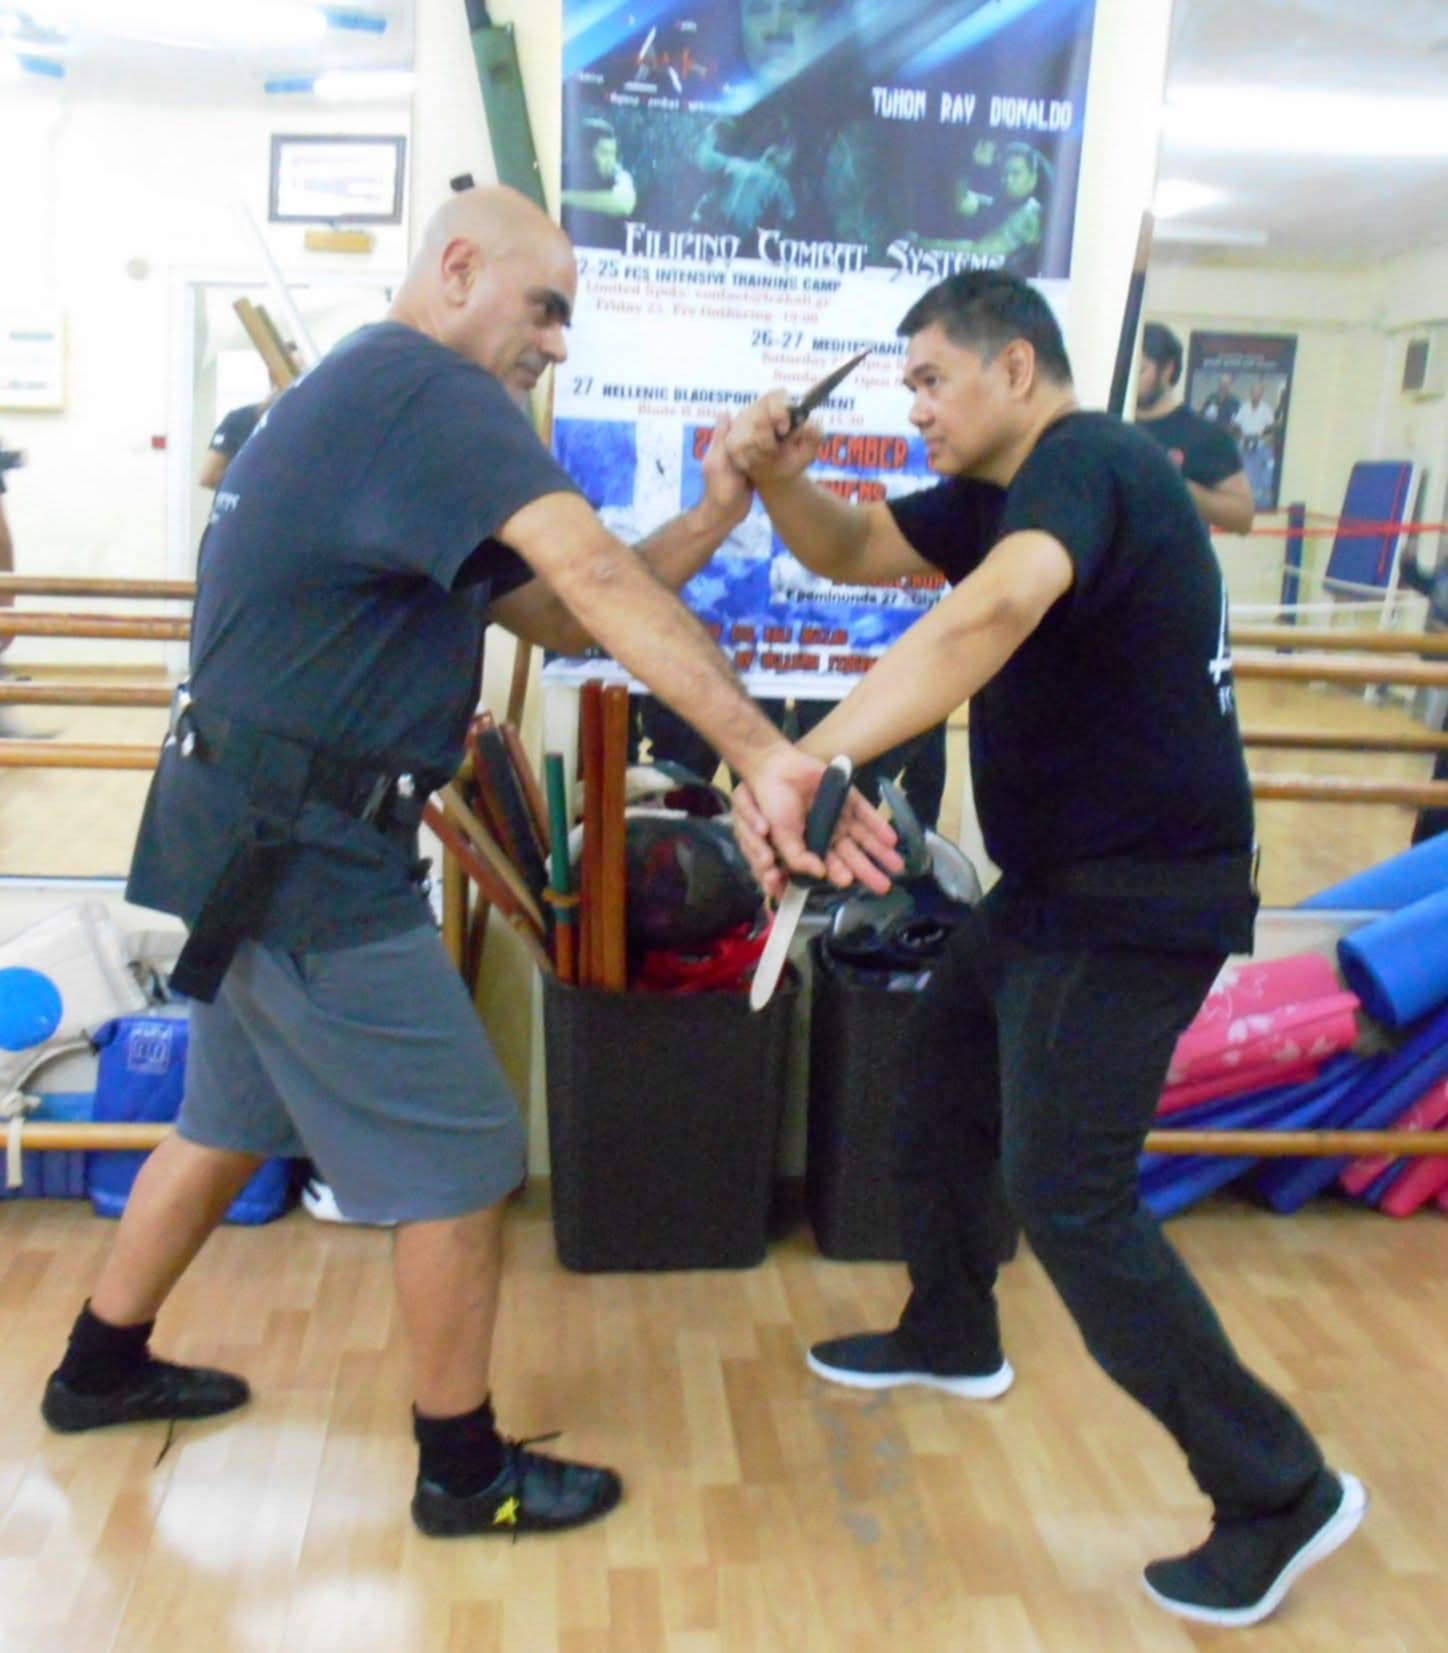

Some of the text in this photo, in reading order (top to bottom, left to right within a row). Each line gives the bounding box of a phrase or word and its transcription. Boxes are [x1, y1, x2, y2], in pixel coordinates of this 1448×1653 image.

[872, 86, 927, 121] TUHON
[939, 91, 976, 125] RAY
[655, 268, 726, 286] INTENSIVE
[732, 272, 799, 291] TRAINING
[802, 277, 842, 294] CAMP
[573, 376, 594, 396] 27
[602, 383, 669, 400] HELLENIC
